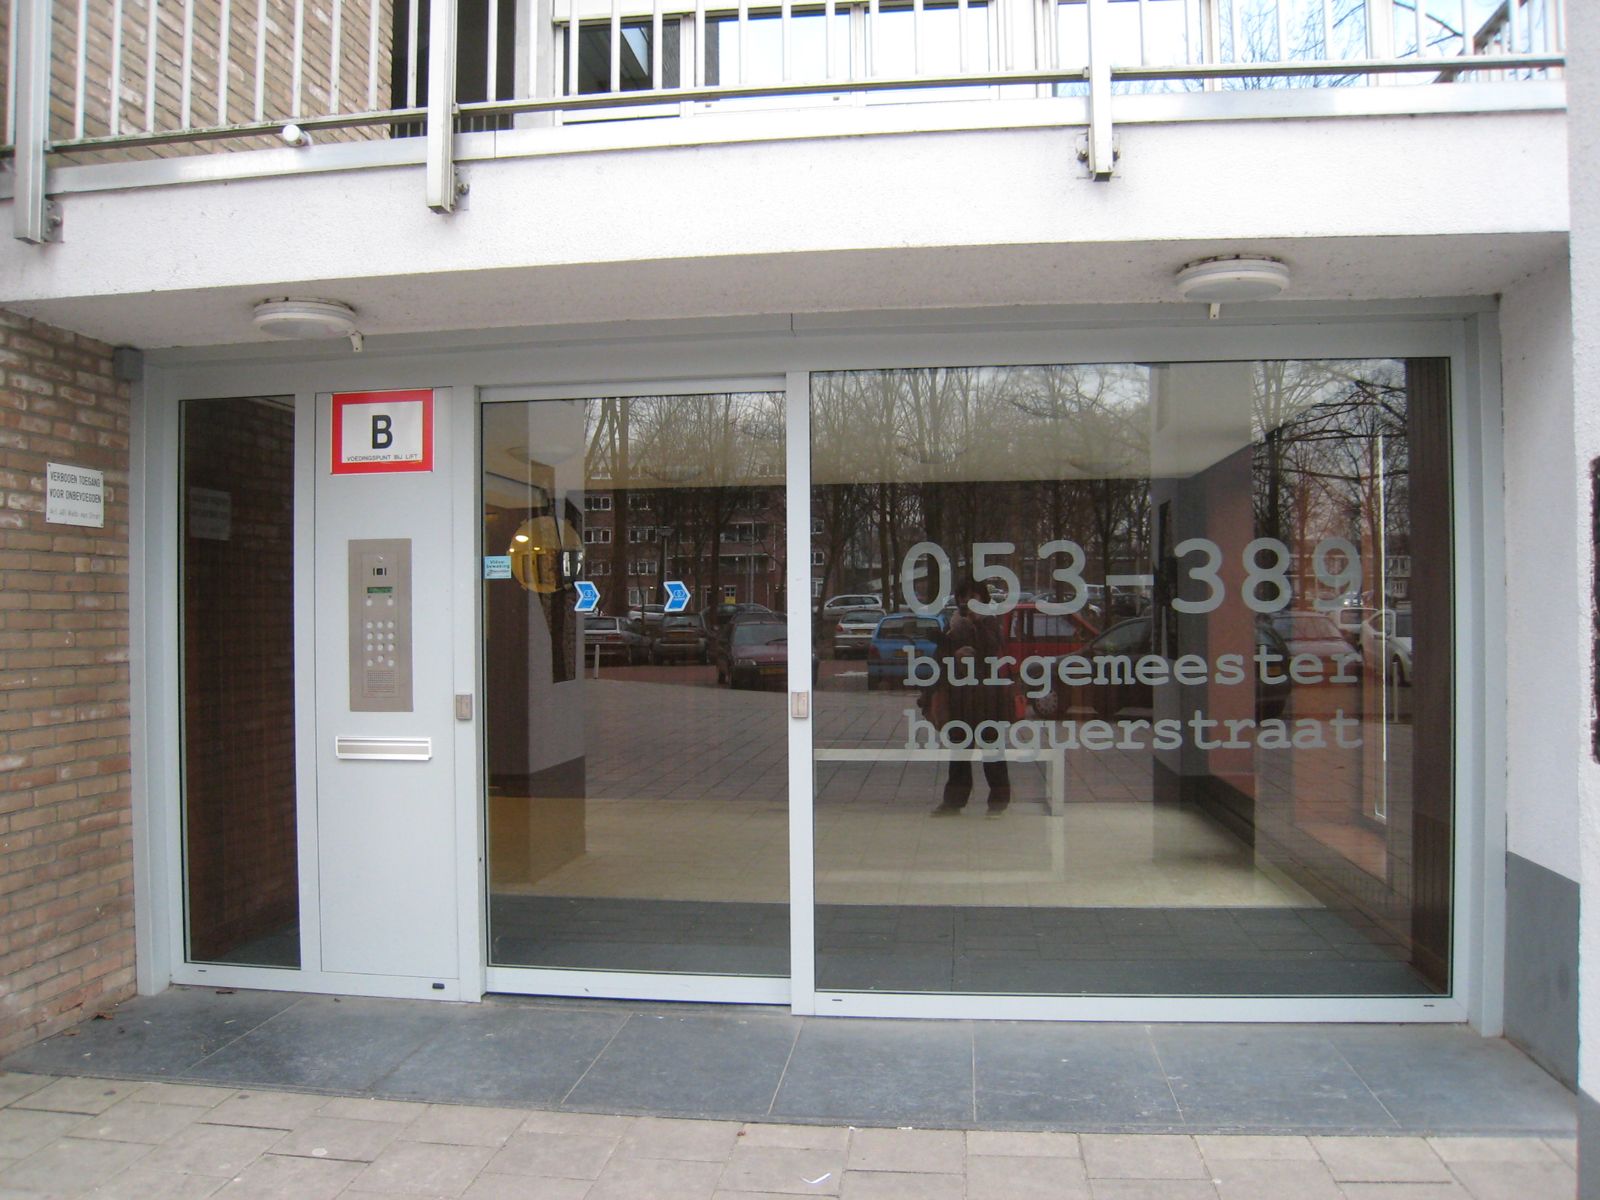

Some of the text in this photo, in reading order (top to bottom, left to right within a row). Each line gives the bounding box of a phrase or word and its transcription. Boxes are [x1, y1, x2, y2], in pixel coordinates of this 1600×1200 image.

[371, 414, 394, 449] B
[49, 488, 64, 498] VOOR
[50, 471, 101, 487] VERBODEN TOEGANG
[902, 538, 1363, 616] 053-389
[903, 645, 1363, 699] burgemeester
[903, 708, 1364, 763] hogguerstraat
